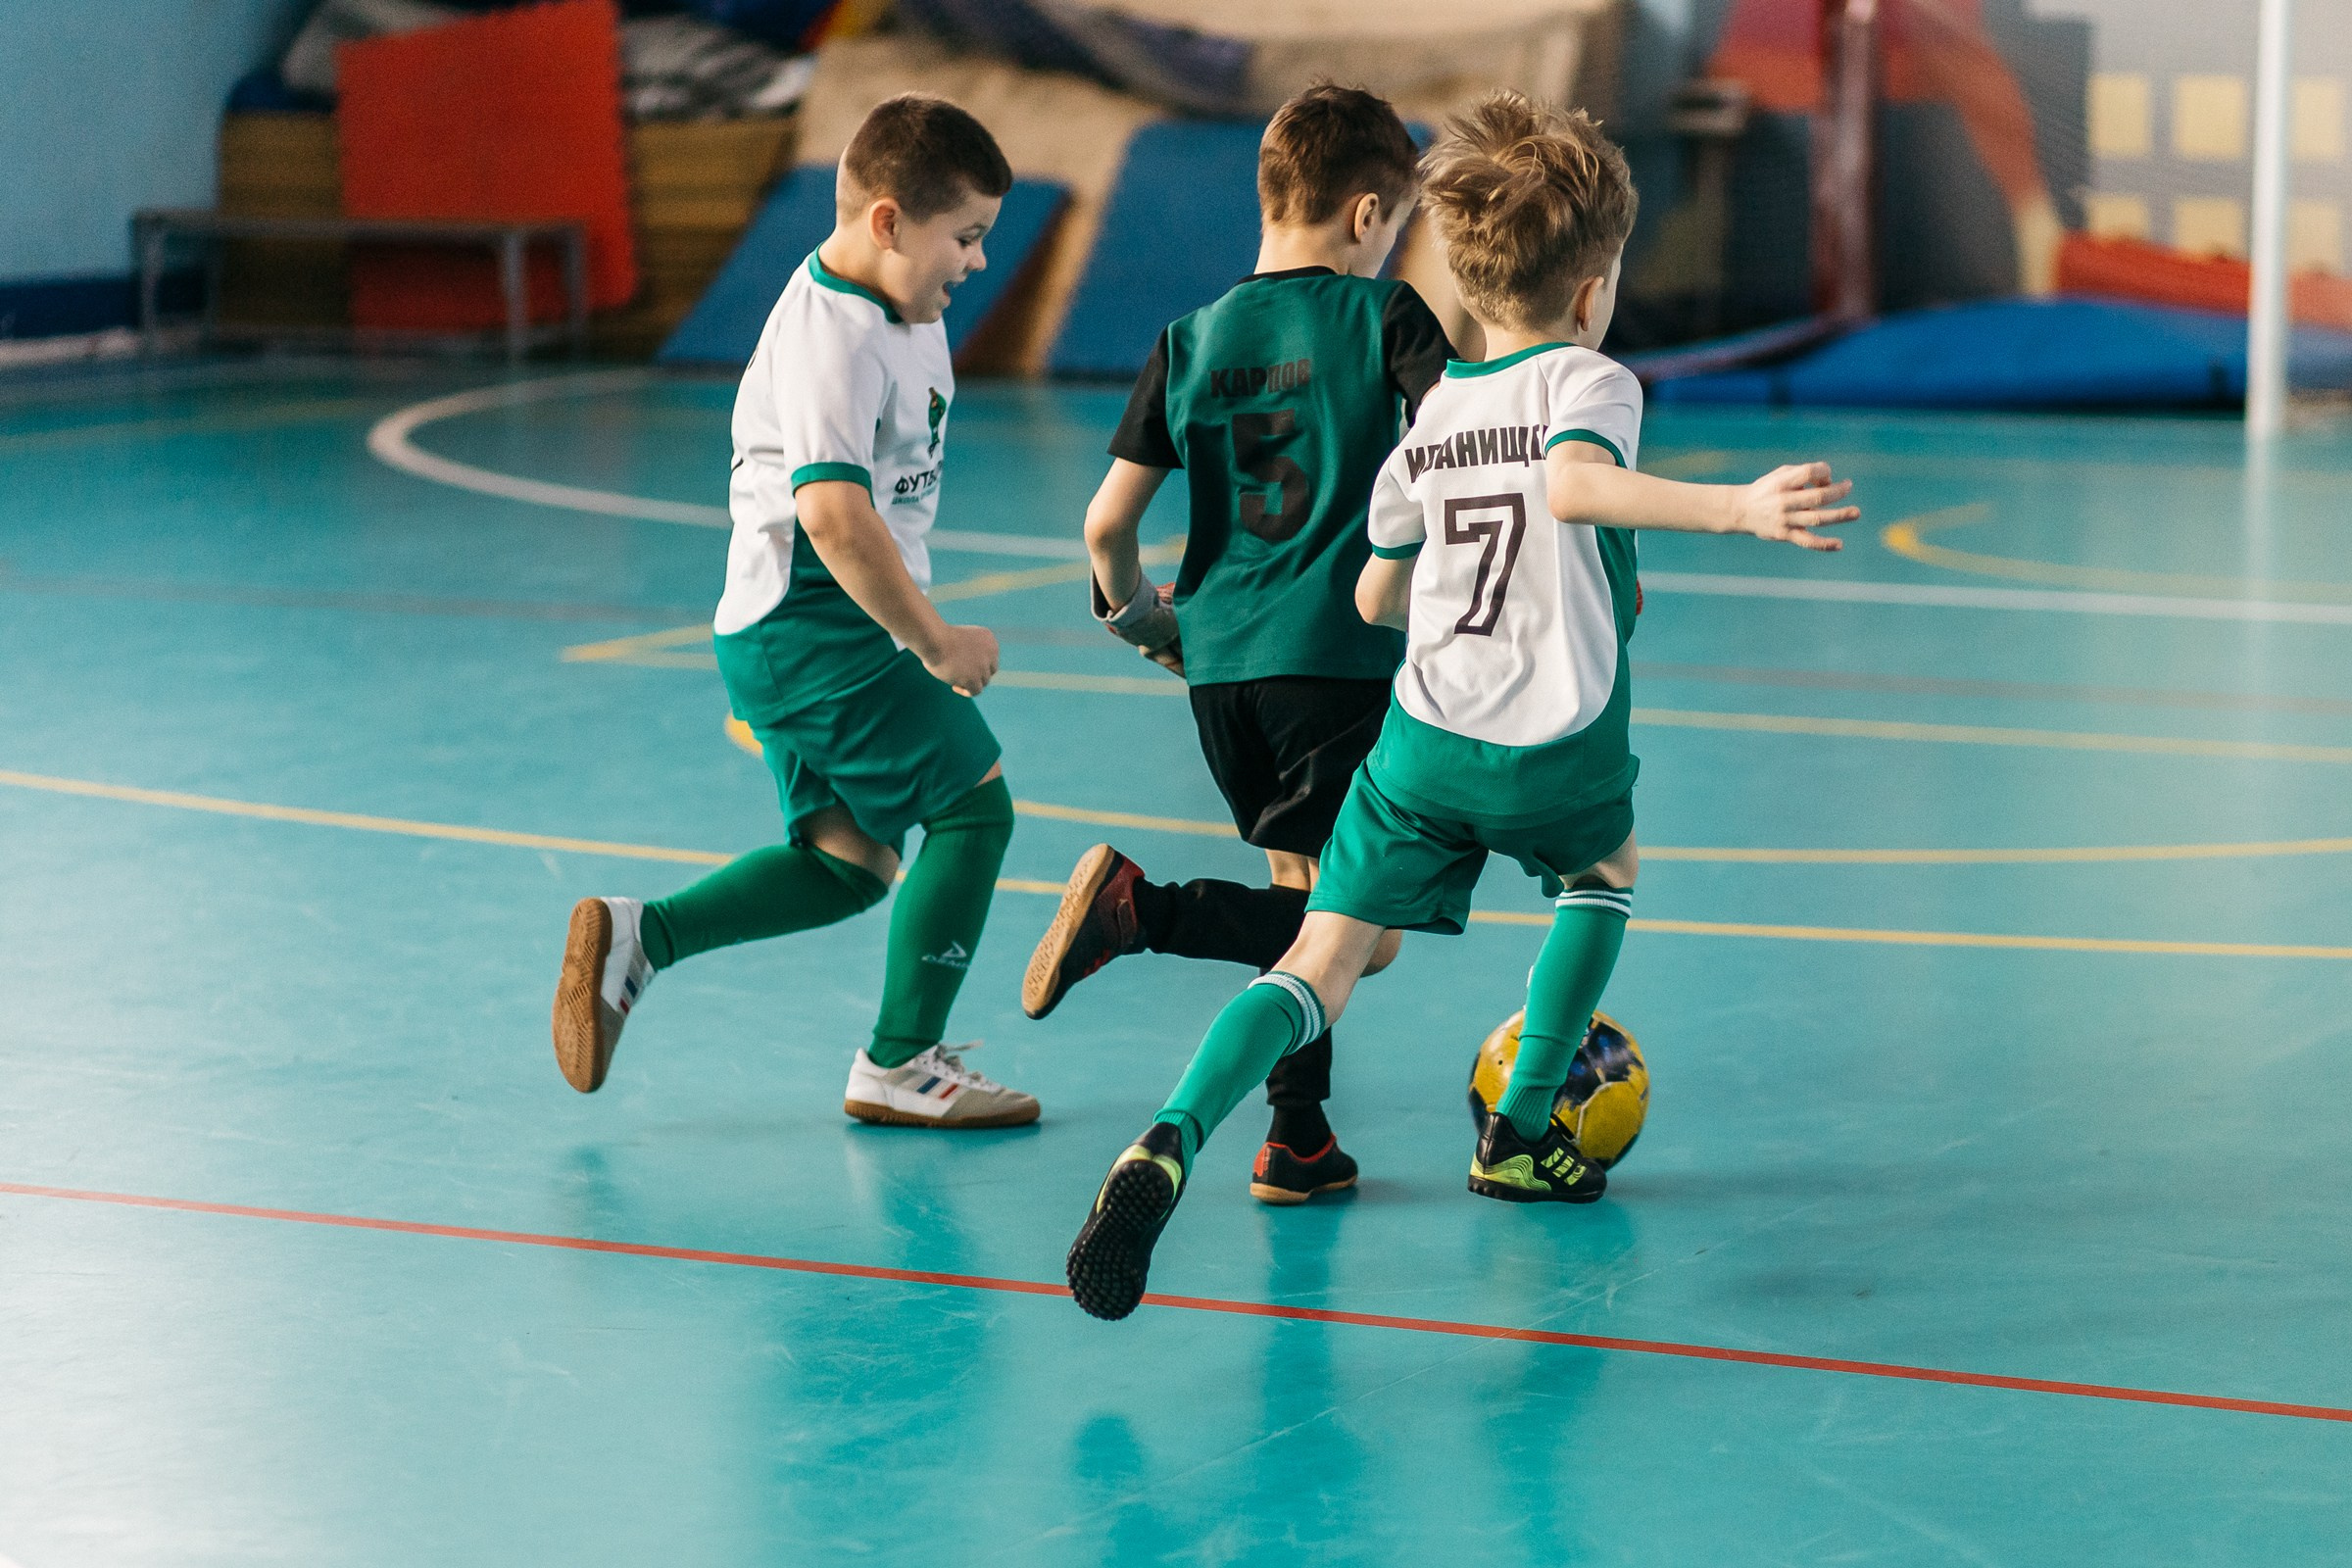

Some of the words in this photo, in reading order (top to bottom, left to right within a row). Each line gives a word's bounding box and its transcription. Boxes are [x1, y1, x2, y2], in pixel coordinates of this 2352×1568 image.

[1210, 359, 1312, 398] КАРПОВ
[1232, 408, 1309, 542] 5
[1445, 492, 1527, 637] 7
